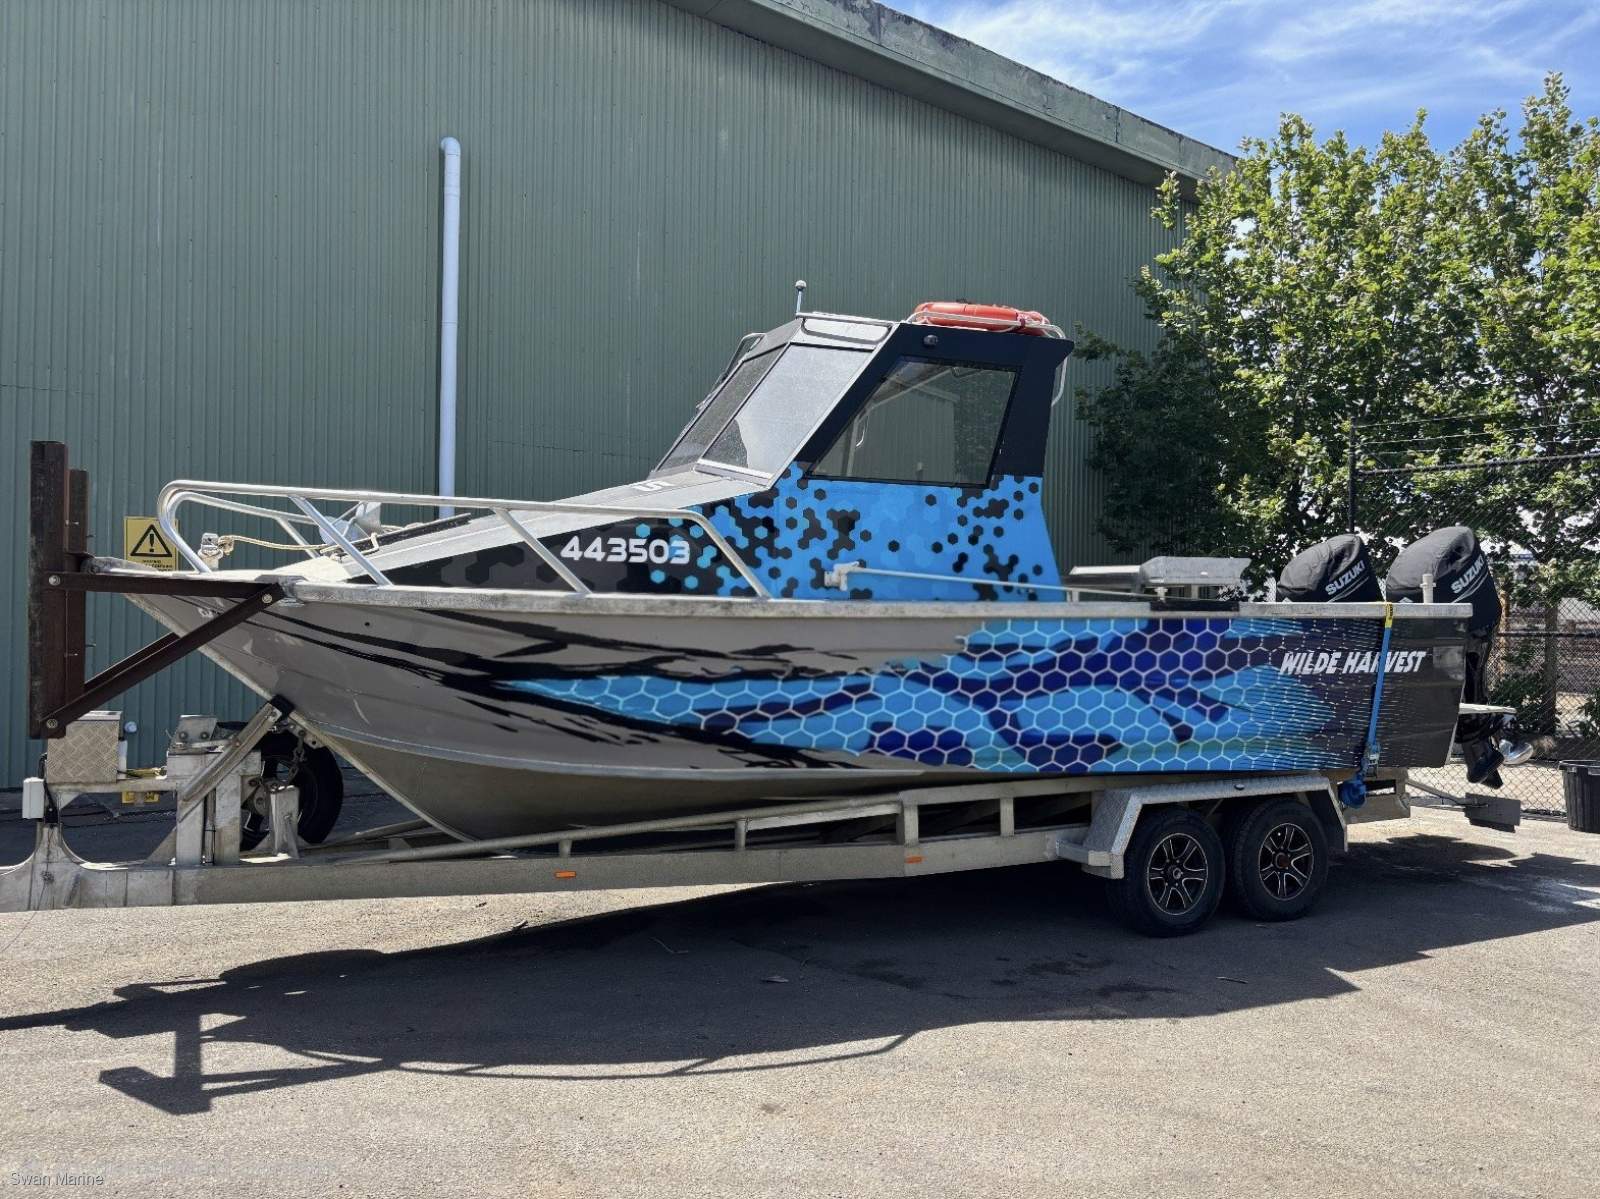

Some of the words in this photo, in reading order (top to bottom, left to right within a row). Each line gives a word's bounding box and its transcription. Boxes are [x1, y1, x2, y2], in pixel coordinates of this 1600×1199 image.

[560, 535, 690, 564] 443503
[1325, 560, 1367, 595] SUZUKI
[1451, 555, 1485, 594] SUZUKI
[1279, 651, 1342, 675] WILDE
